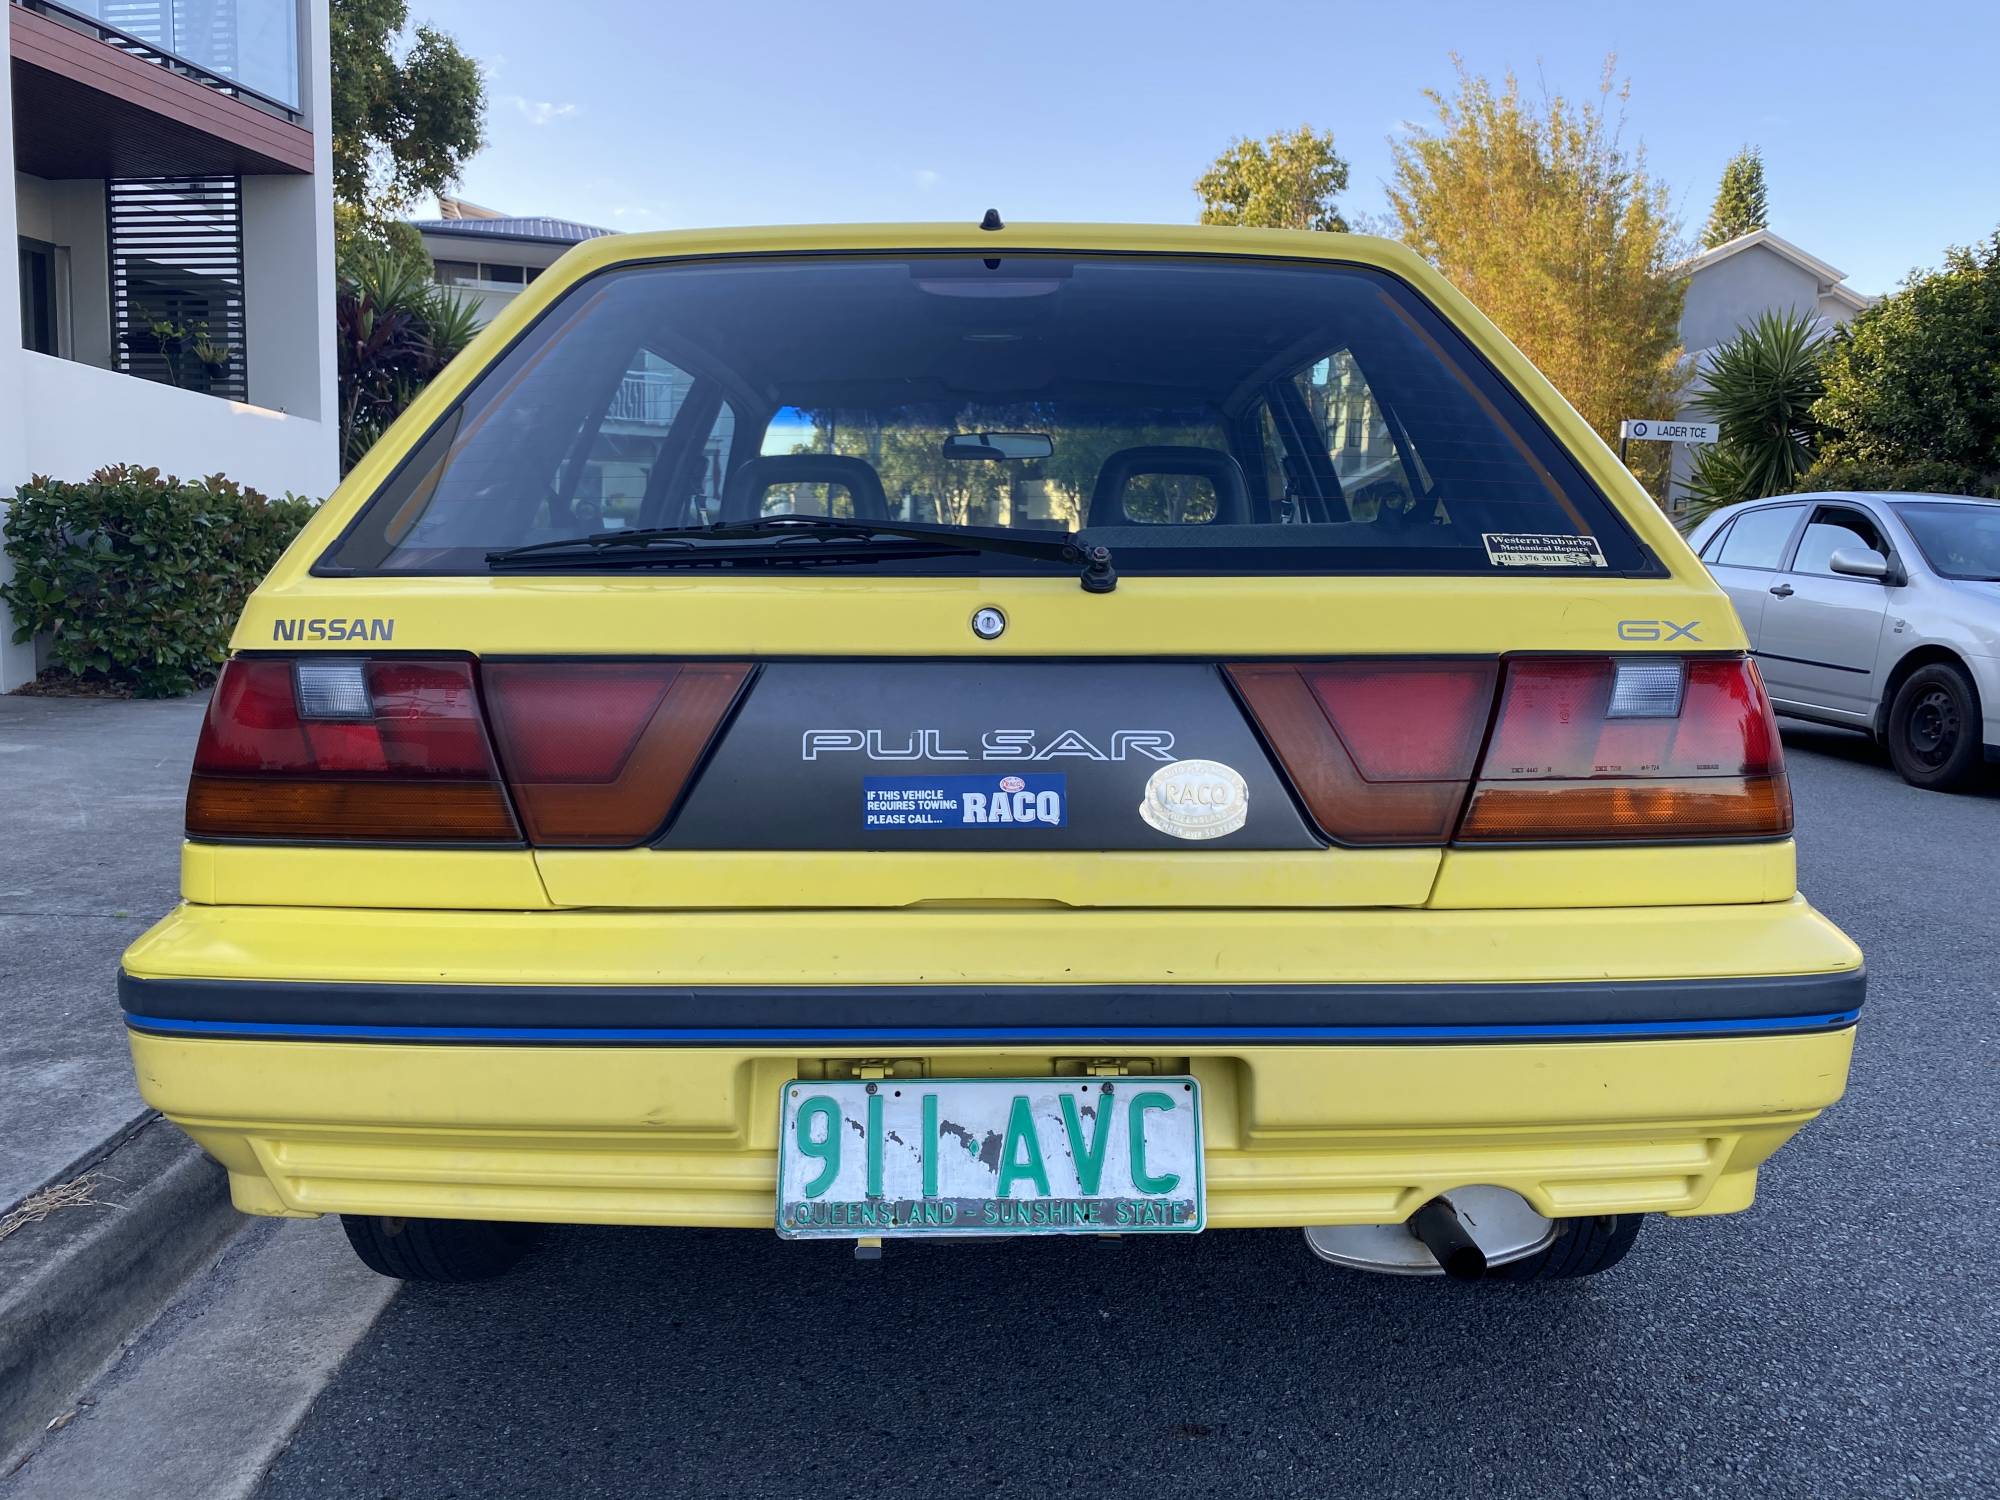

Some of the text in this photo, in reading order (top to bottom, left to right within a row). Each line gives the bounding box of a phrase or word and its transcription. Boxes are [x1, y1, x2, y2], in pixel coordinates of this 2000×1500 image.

[1657, 425, 1707, 438] LADER TCE
[1491, 536, 1592, 546] Western Suburbs
[273, 619, 395, 641] NISSAN
[1618, 620, 1703, 642] GX
[803, 729, 1178, 761] PULSAR
[867, 790, 944, 801] IF THIS VEHICLE
[867, 800, 958, 811] REQUIRES TOWING
[1164, 783, 1225, 808] RACQ
[962, 791, 1061, 825] RACQ
[867, 814, 943, 825] PLEASE CALL...
[797, 1092, 1182, 1199] 911 AVC
[795, 1202, 957, 1225] QUEENSLAND
[983, 1201, 1100, 1225] SUNSHINE
[1114, 1201, 1185, 1225] STATE
